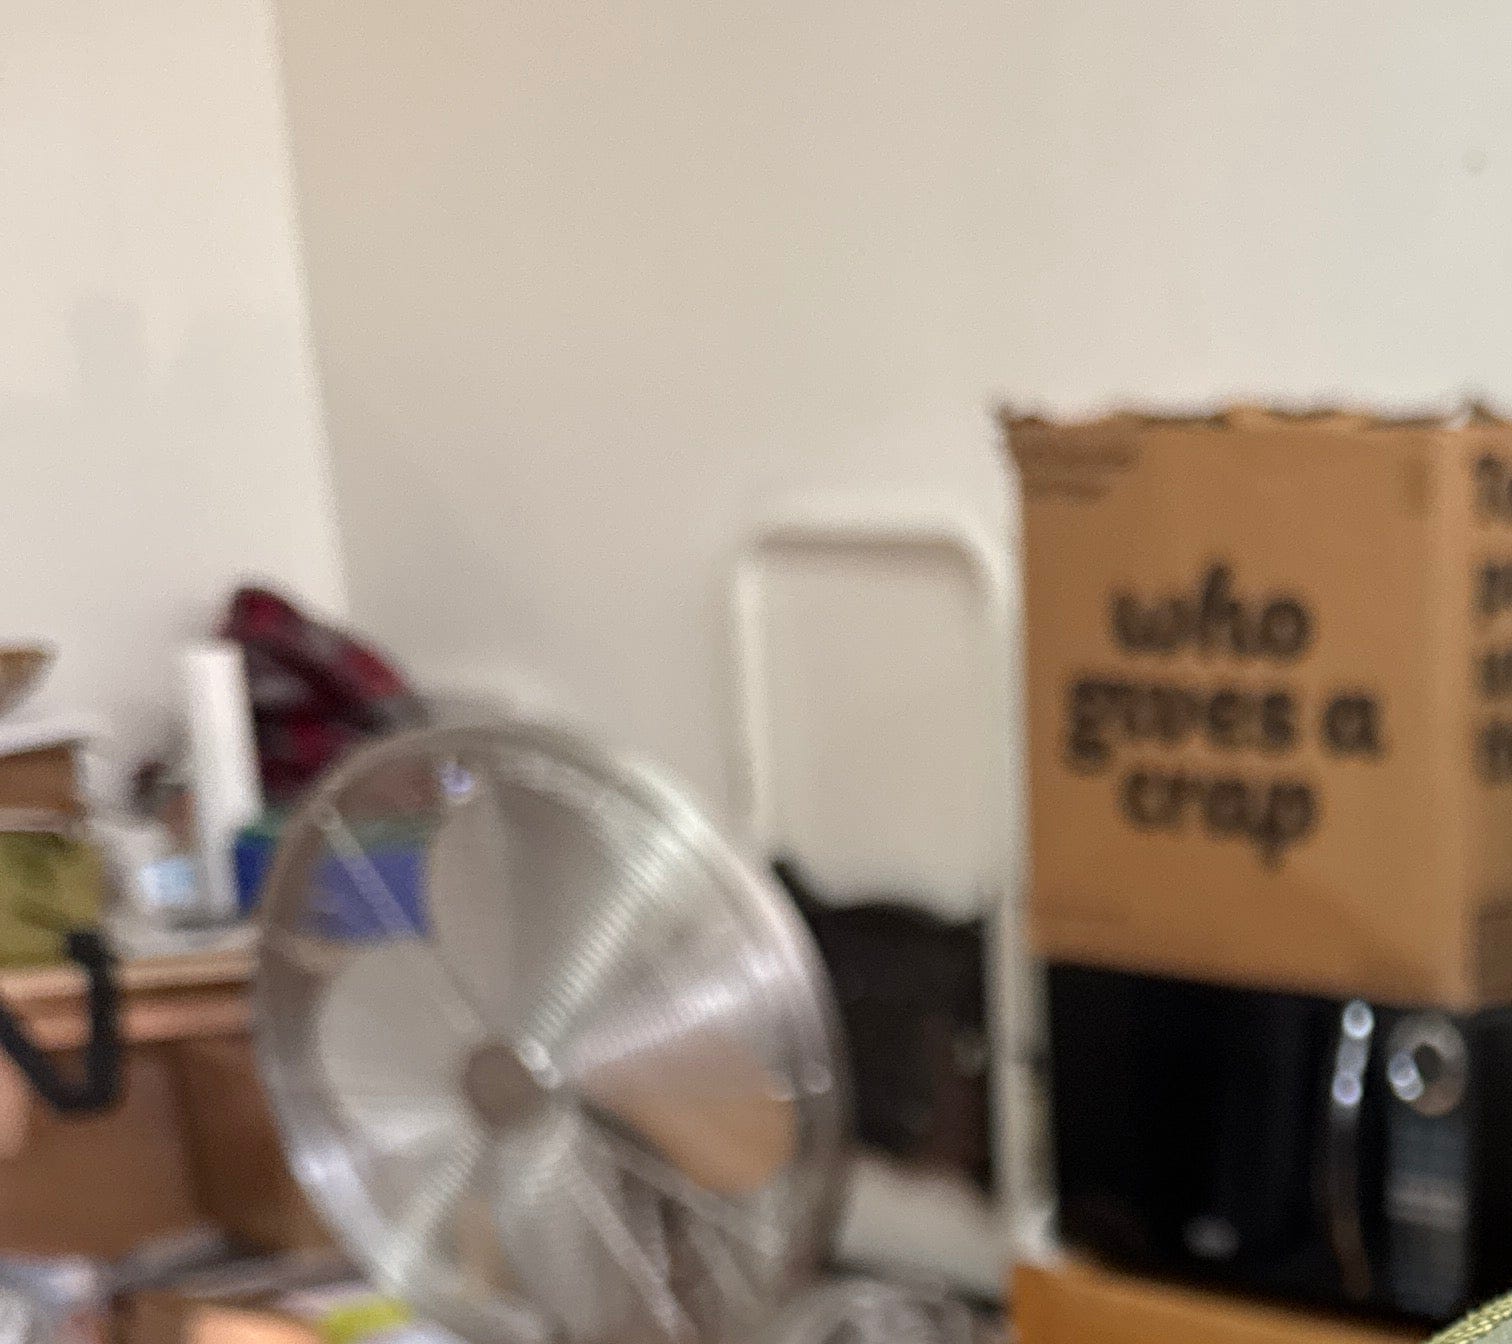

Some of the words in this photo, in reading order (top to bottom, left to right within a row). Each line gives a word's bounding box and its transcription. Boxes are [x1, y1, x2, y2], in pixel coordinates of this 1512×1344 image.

[1109, 557, 1313, 661] who
[1321, 691, 1385, 761] a
[1120, 770, 1320, 870] crap
